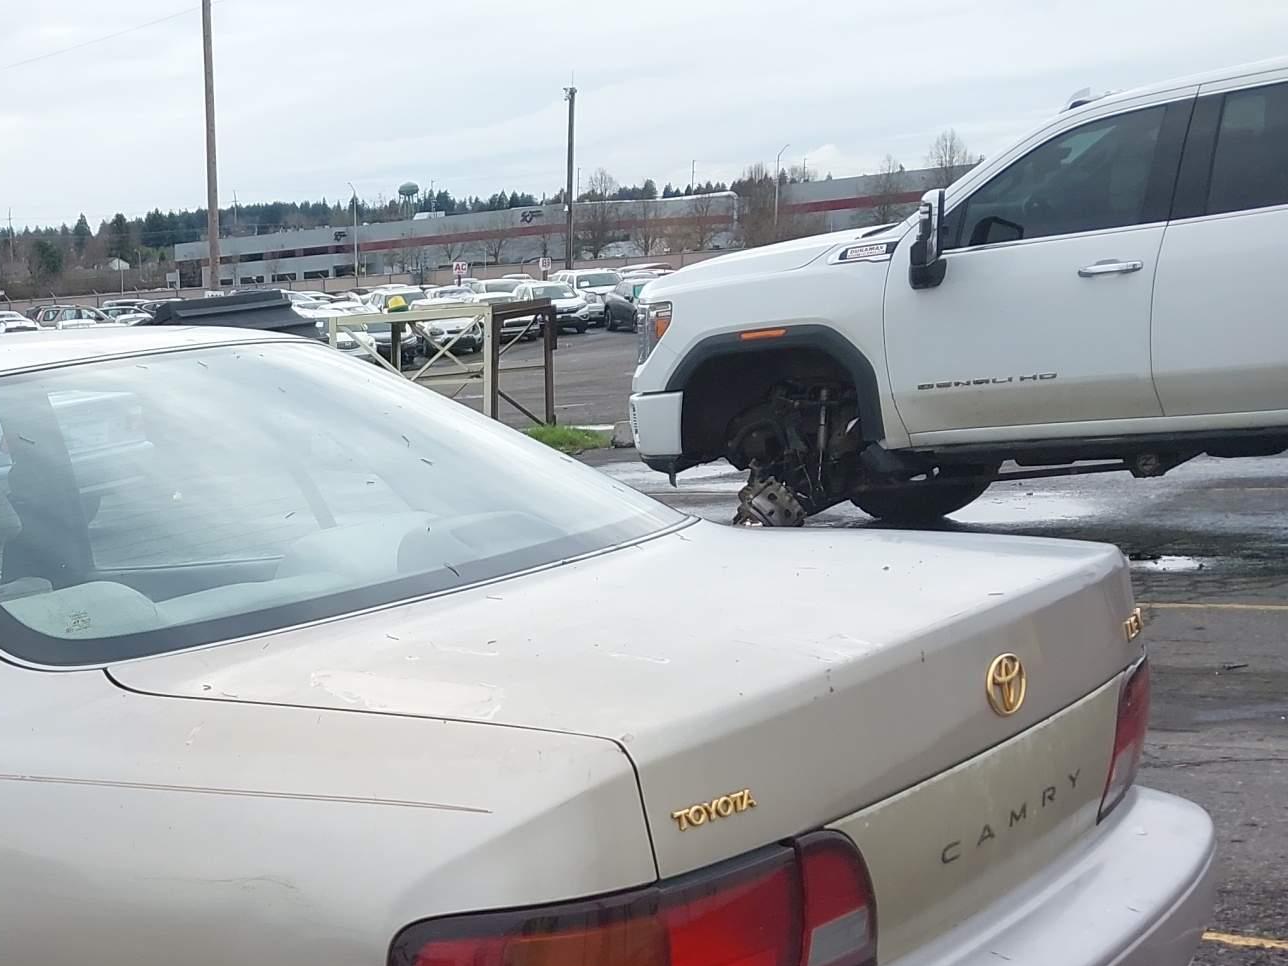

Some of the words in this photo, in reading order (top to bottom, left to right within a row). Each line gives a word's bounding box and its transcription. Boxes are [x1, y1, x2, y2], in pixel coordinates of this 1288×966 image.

[1019, 371, 1057, 382] HD
[671, 788, 758, 831] TOYOTA
[941, 767, 1080, 864] CAMRY
